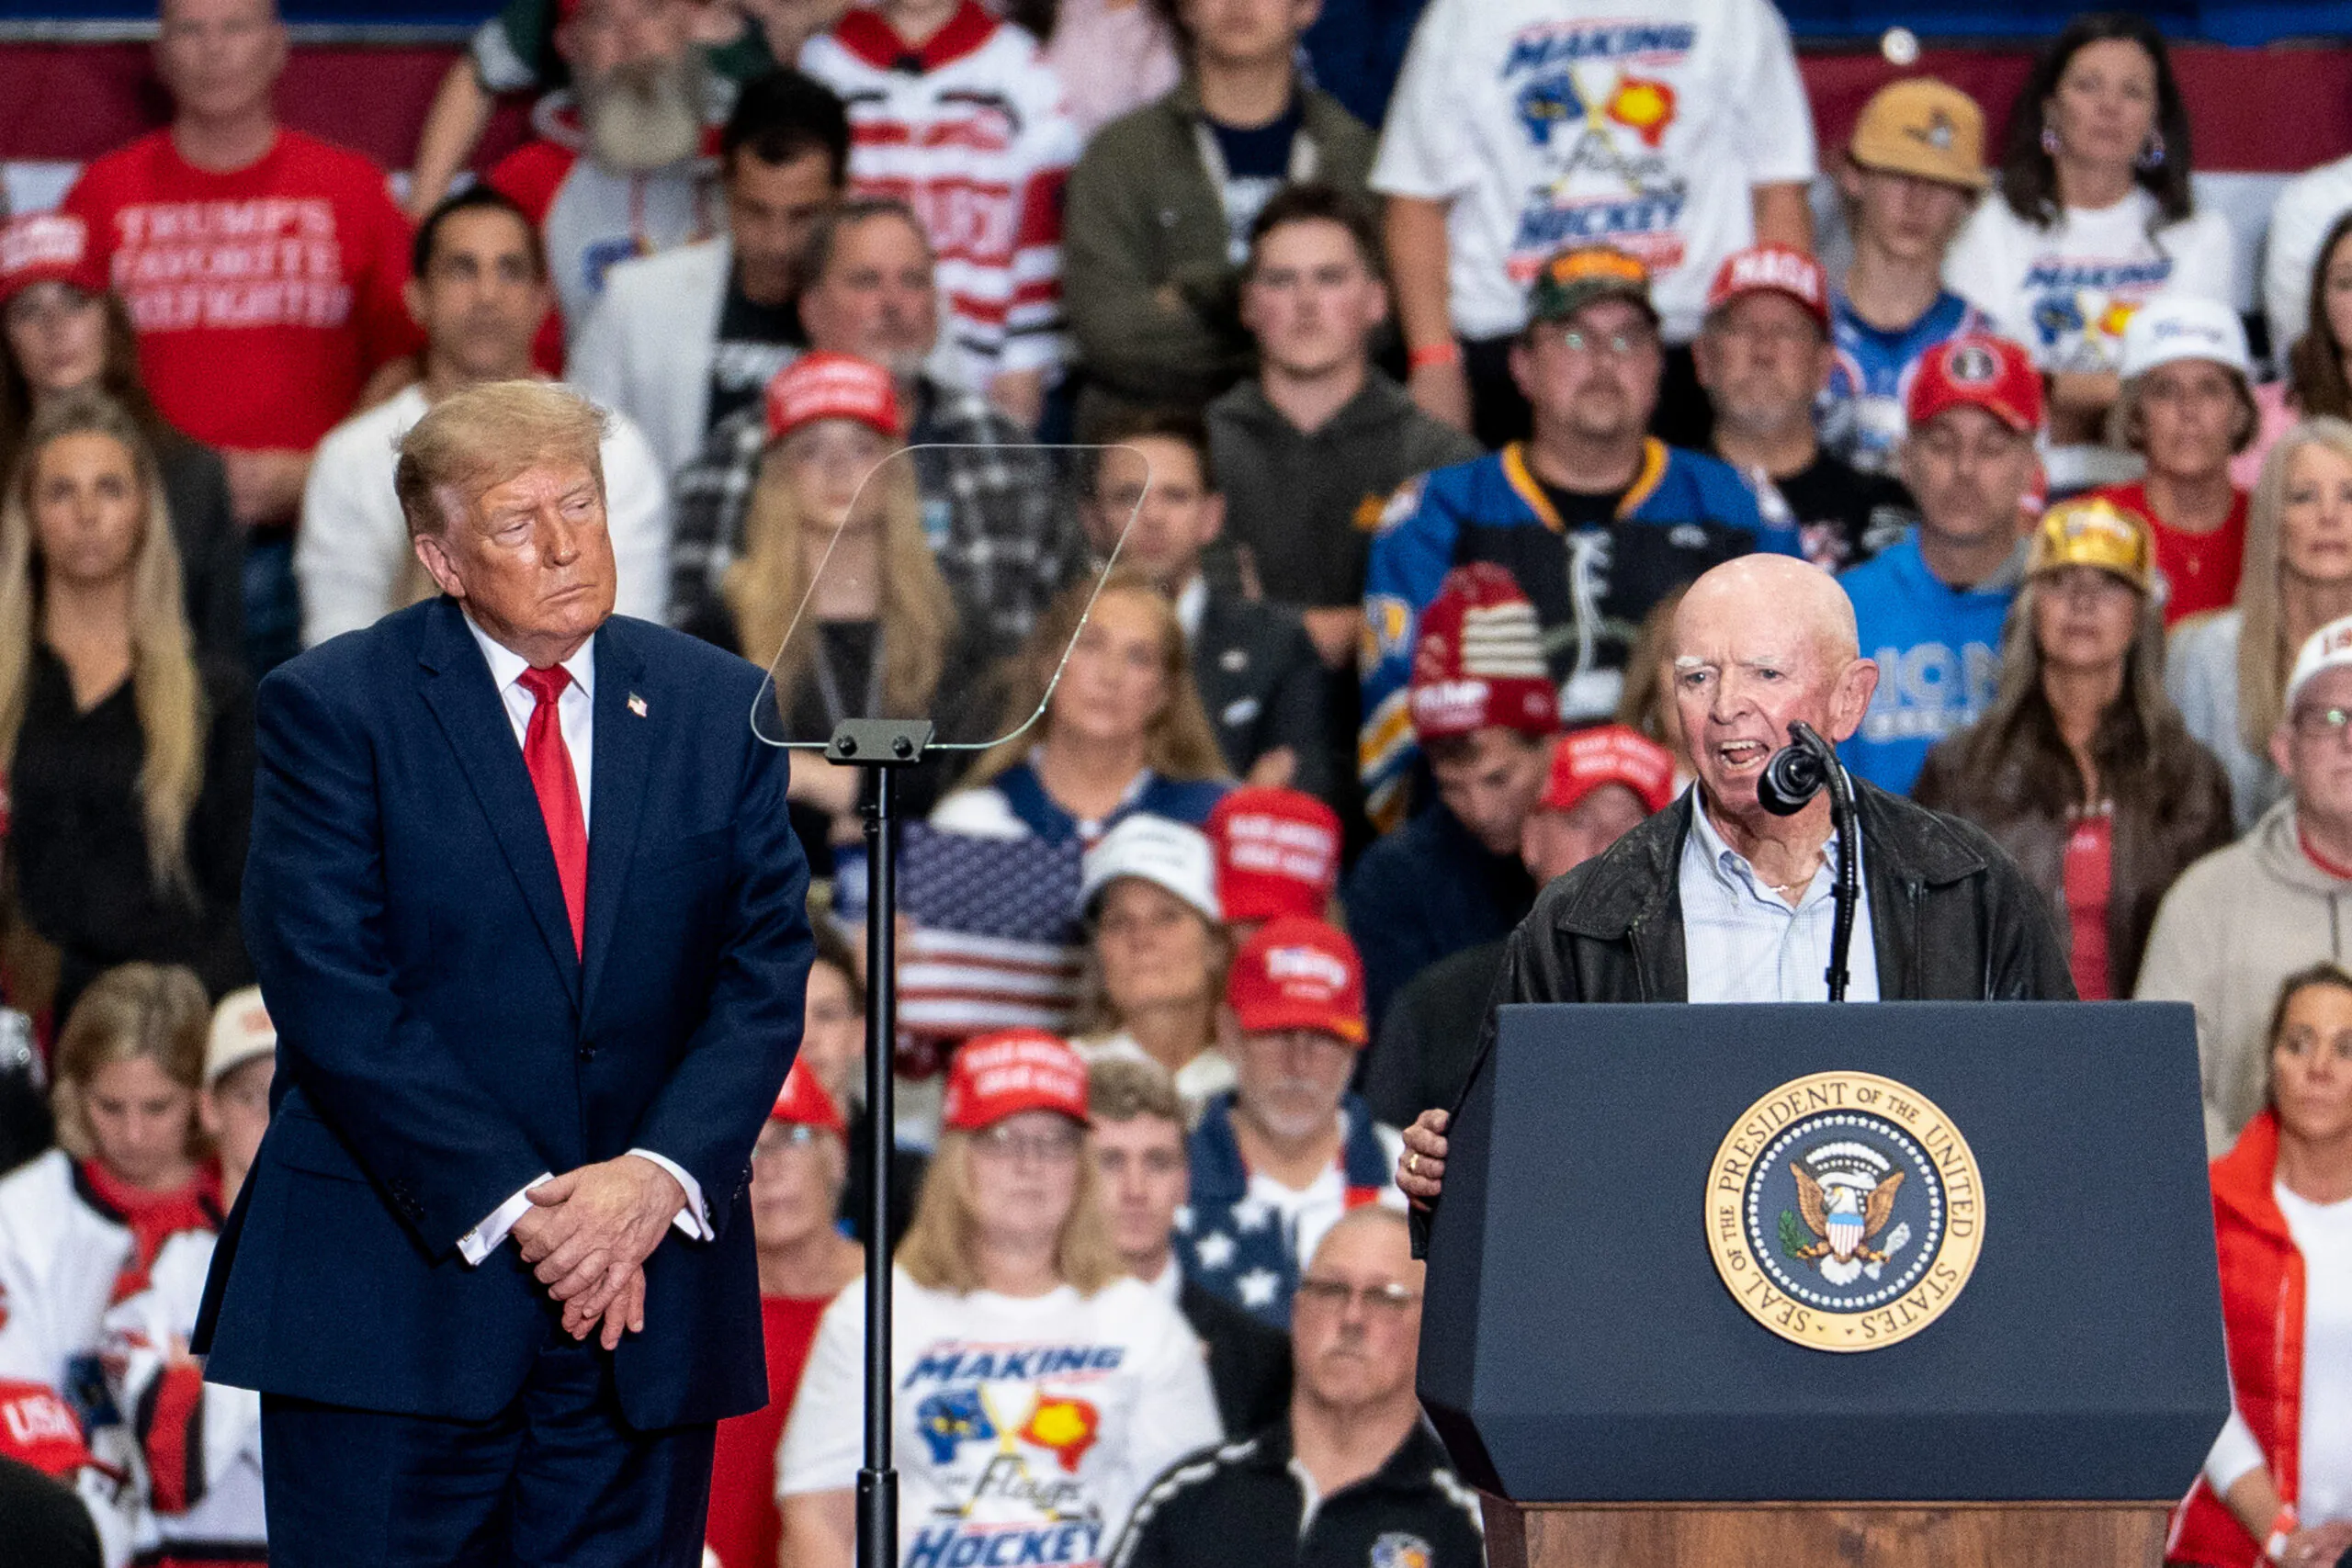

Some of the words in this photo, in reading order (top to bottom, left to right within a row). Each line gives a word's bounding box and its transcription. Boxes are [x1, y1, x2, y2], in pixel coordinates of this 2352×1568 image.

[1871, 641, 2004, 708] ION
[1856, 1088, 1883, 1104] OF
[1886, 1094, 1922, 1125] THE
[1718, 1082, 1848, 1193] PRESIDENT
[1924, 1123, 1974, 1238] UNITED
[1719, 1205, 1737, 1241] THE
[1726, 1247, 1746, 1271] OF
[1745, 1270, 1812, 1333] SEAL
[1860, 1261, 1957, 1339] STATES
[901, 1347, 1125, 1390] MAKING
[902, 1523, 1105, 1568] HOCKEY
